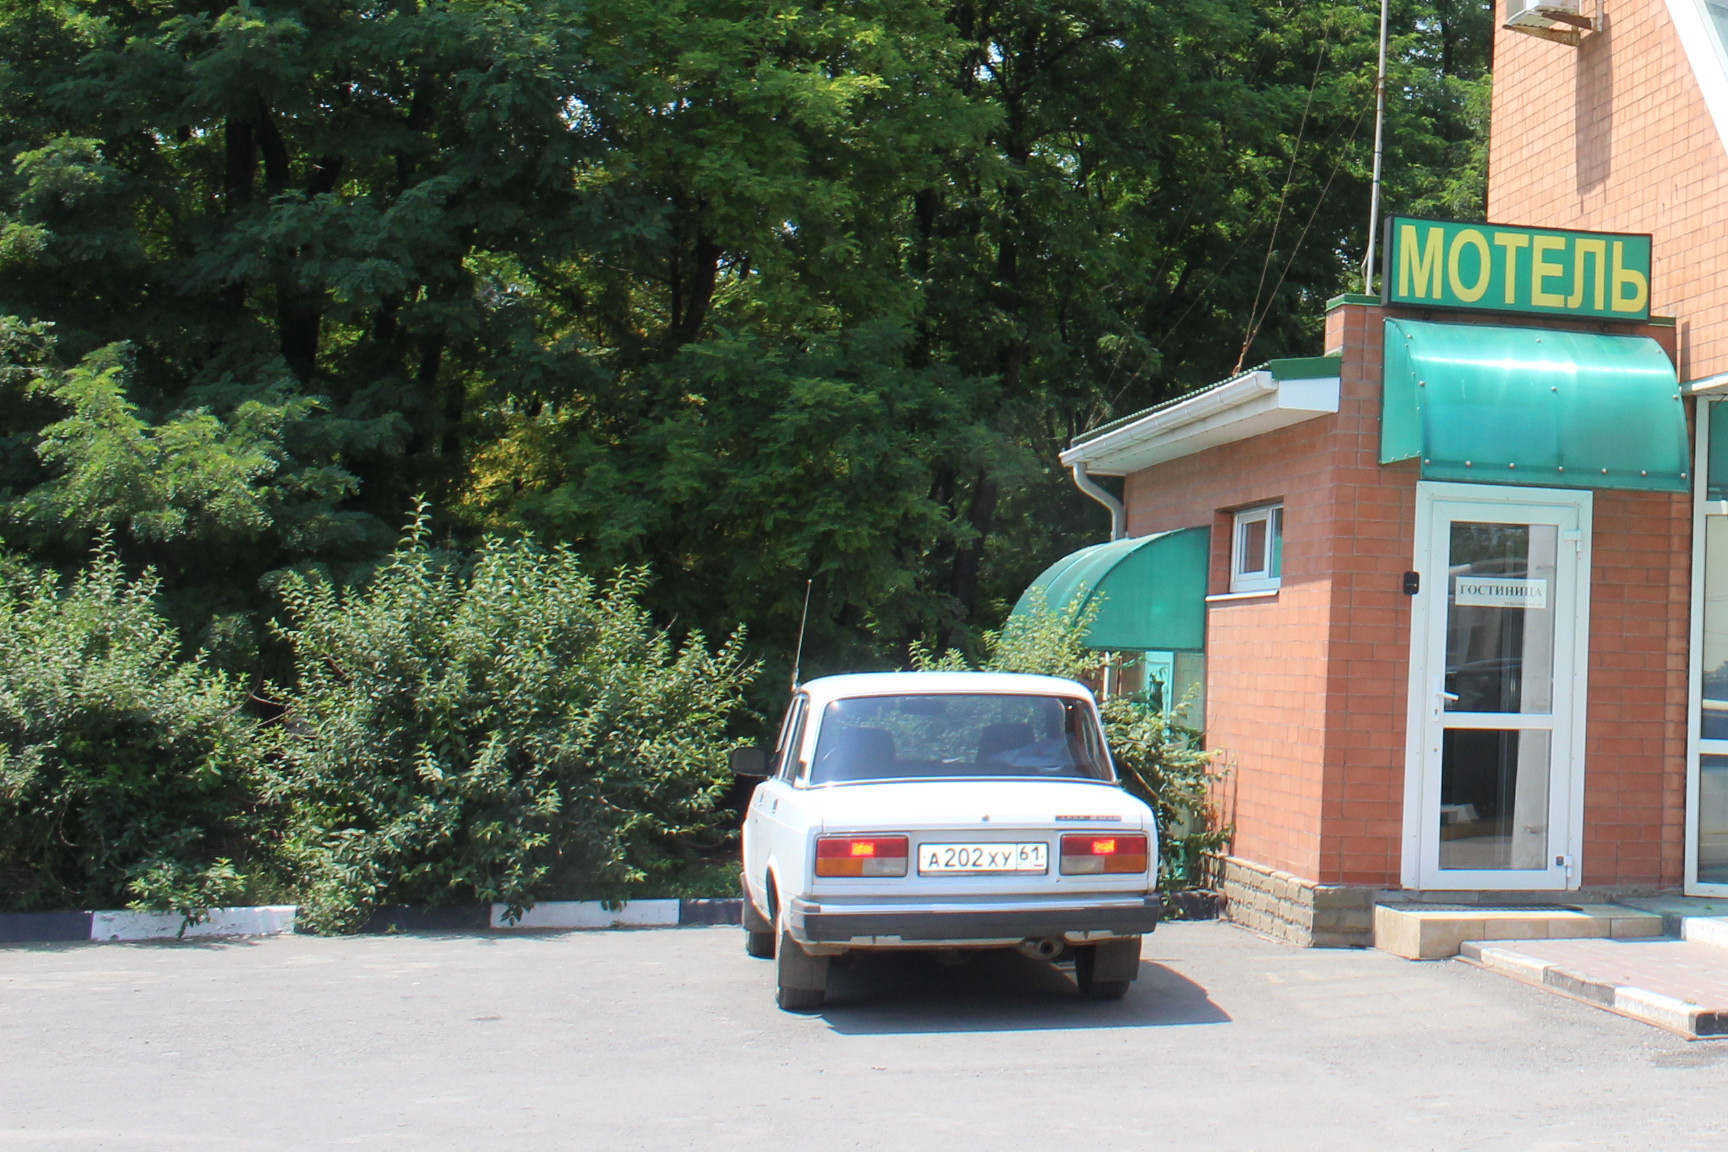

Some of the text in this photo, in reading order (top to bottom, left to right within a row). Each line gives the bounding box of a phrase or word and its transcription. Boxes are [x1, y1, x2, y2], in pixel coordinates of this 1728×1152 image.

[1398, 224, 1649, 313] МОТЕЛЬ
[1460, 584, 1542, 597] ГОСТИНИЦА
[1019, 845, 1040, 861] 61
